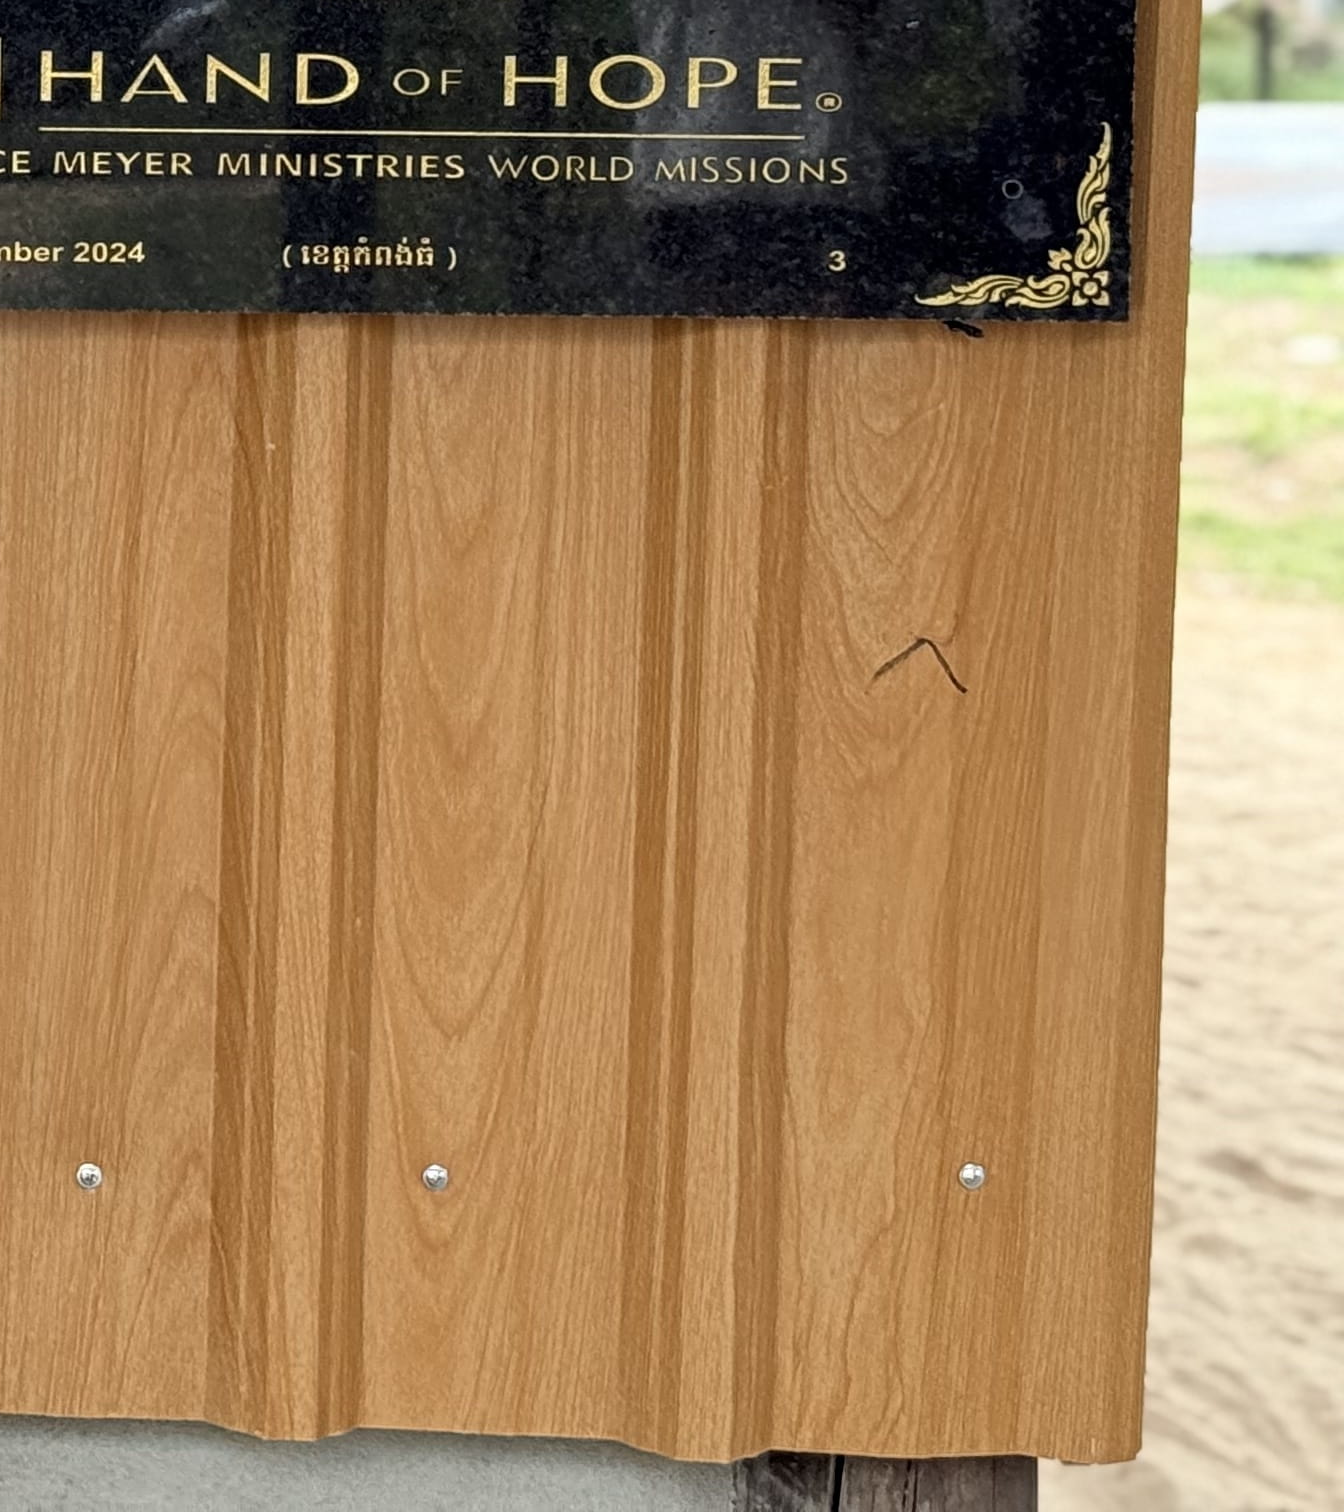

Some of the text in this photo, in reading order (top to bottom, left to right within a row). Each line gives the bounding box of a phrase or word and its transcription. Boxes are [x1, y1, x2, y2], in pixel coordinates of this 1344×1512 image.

[39, 49, 361, 106] HAND
[390, 66, 466, 98] OF
[53, 150, 193, 176] MEYER
[217, 151, 466, 180] MINISTRIES
[487, 153, 635, 184] WORLD
[655, 155, 850, 186] MISSIONS
[72, 240, 147, 264] 2024
[828, 251, 847, 272] 3
